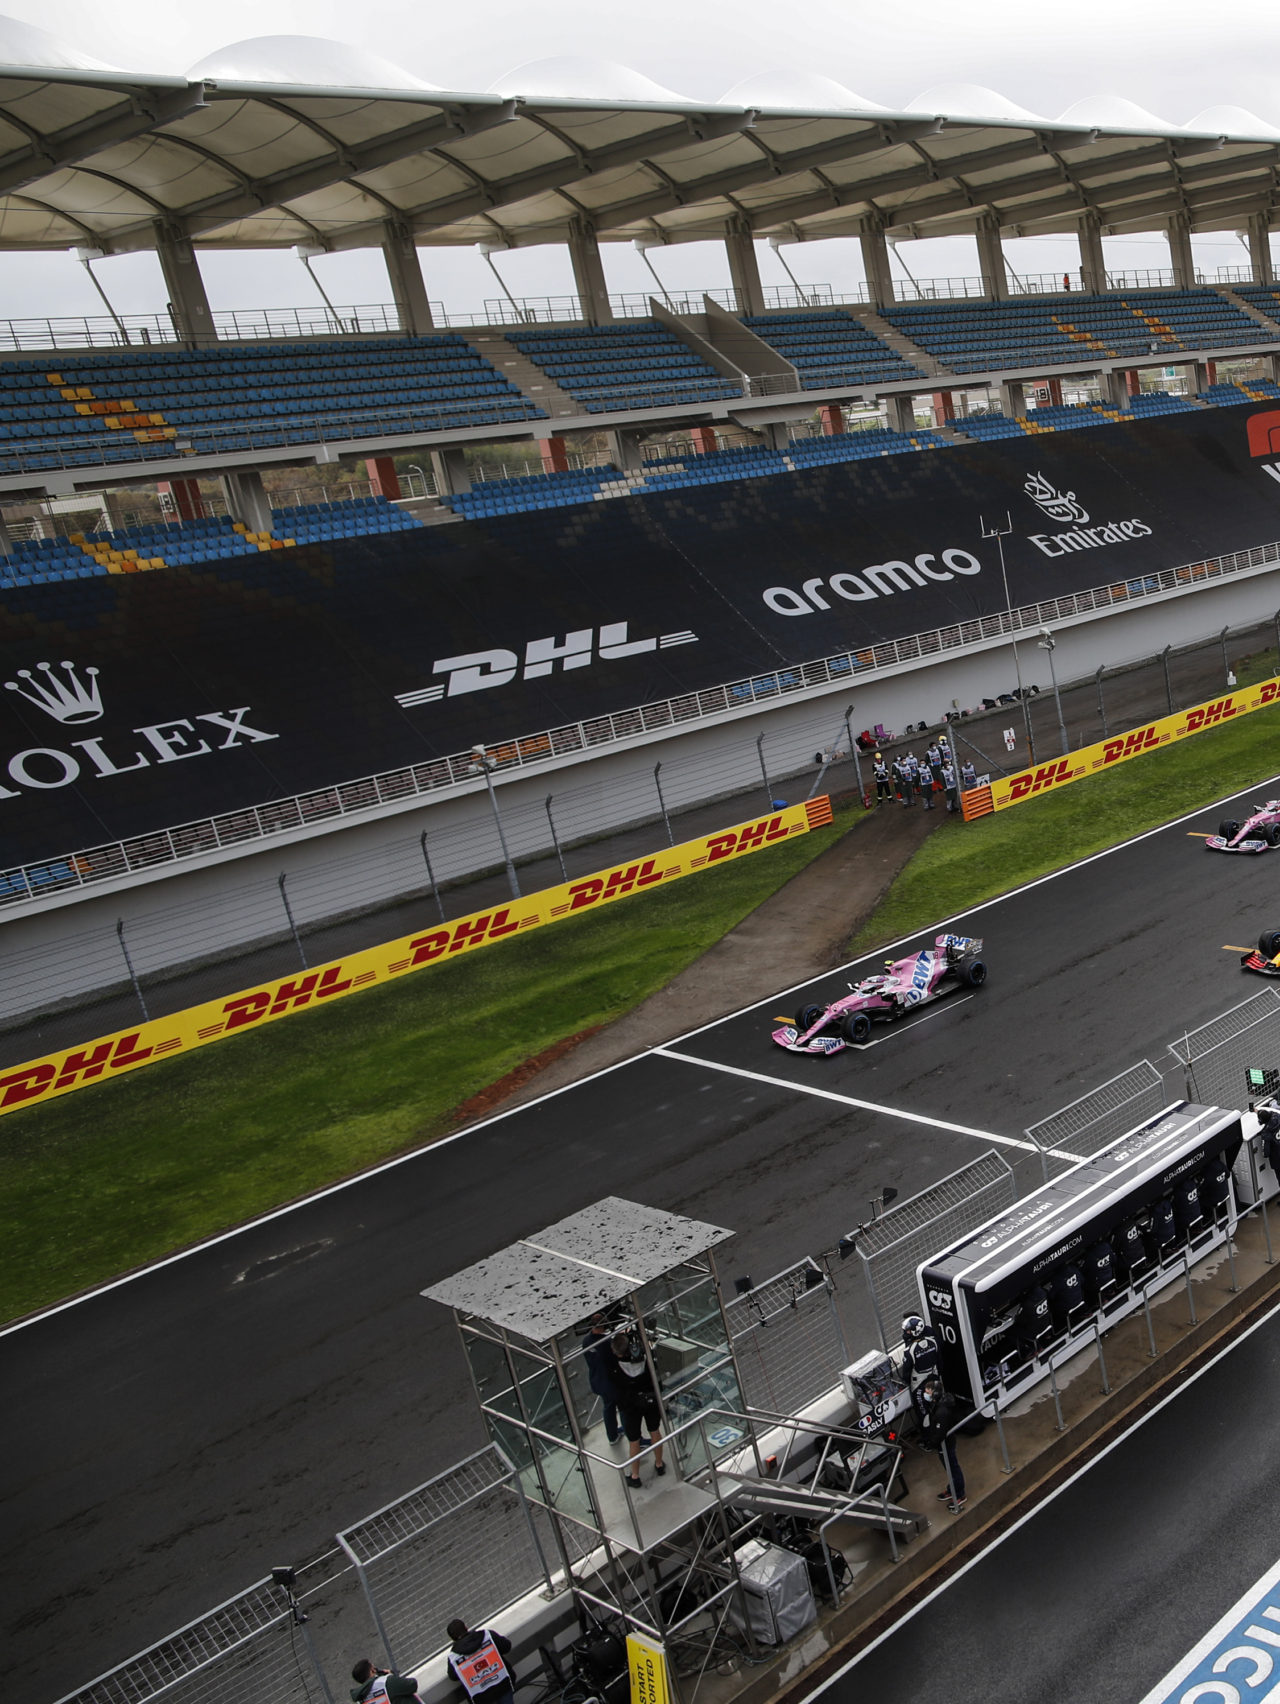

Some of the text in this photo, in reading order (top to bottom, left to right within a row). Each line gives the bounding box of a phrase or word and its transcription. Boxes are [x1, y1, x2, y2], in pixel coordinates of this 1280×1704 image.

[1026, 518, 1153, 558] Emirates
[762, 548, 981, 617] aramco
[432, 621, 657, 698] DHL
[1186, 699, 1236, 732] DHL
[1103, 728, 1159, 765] DHL
[1009, 759, 1073, 801] DHL
[706, 817, 789, 862] DHL
[569, 860, 664, 910] DHL
[410, 910, 520, 965] DHL
[912, 950, 931, 990] BWT
[223, 967, 353, 1031] DHL
[825, 1038, 842, 1052] BWT
[0, 1034, 154, 1108] DHL
[998, 1202, 1054, 1239] ALPHATAURI
[1033, 1235, 1083, 1274] ALPHATAURI.COM
[938, 1322, 957, 1344] 10
[637, 1662, 647, 1704] START
[645, 1659, 657, 1704] ORTED
